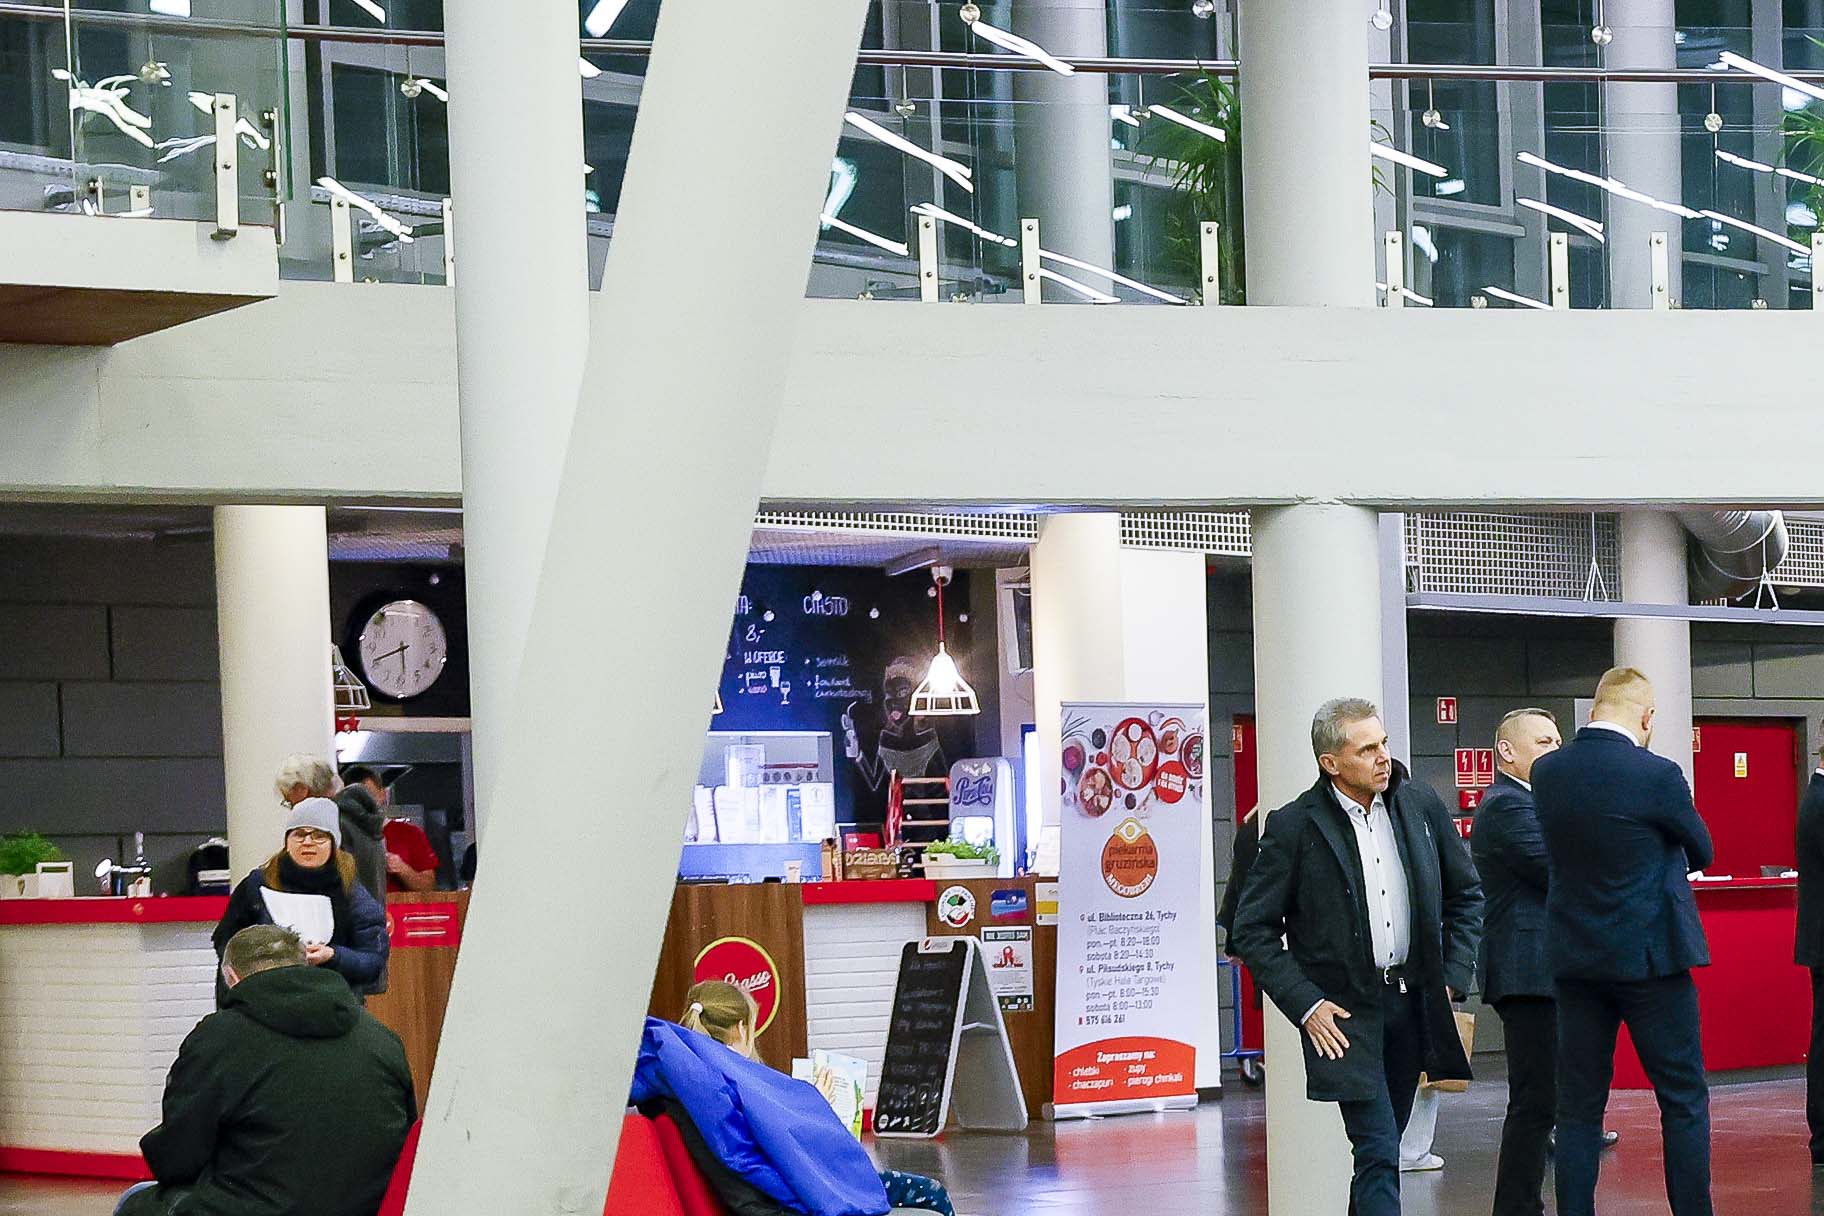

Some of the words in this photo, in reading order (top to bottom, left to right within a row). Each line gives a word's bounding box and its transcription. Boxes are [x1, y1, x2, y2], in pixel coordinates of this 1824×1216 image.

[804, 596, 848, 616] CIASTO
[1109, 844, 1154, 857] piekarnia
[1105, 856, 1155, 872] gruzińska
[1099, 912, 1143, 922] Biblioteczna
[1157, 910, 1176, 922] Tychy
[1087, 951, 1111, 961] sobota
[1098, 962, 1144, 973] Piłsudskiego
[1155, 961, 1174, 972] Tychy
[1086, 1004, 1110, 1012] sobota
[1086, 1015, 1099, 1025] 575
[1096, 1051, 1143, 1064] Zapraszamy
[1128, 1064, 1146, 1074] zupy
[1073, 1079, 1114, 1090] chaczapuri
[1128, 1076, 1153, 1087] pierogi
